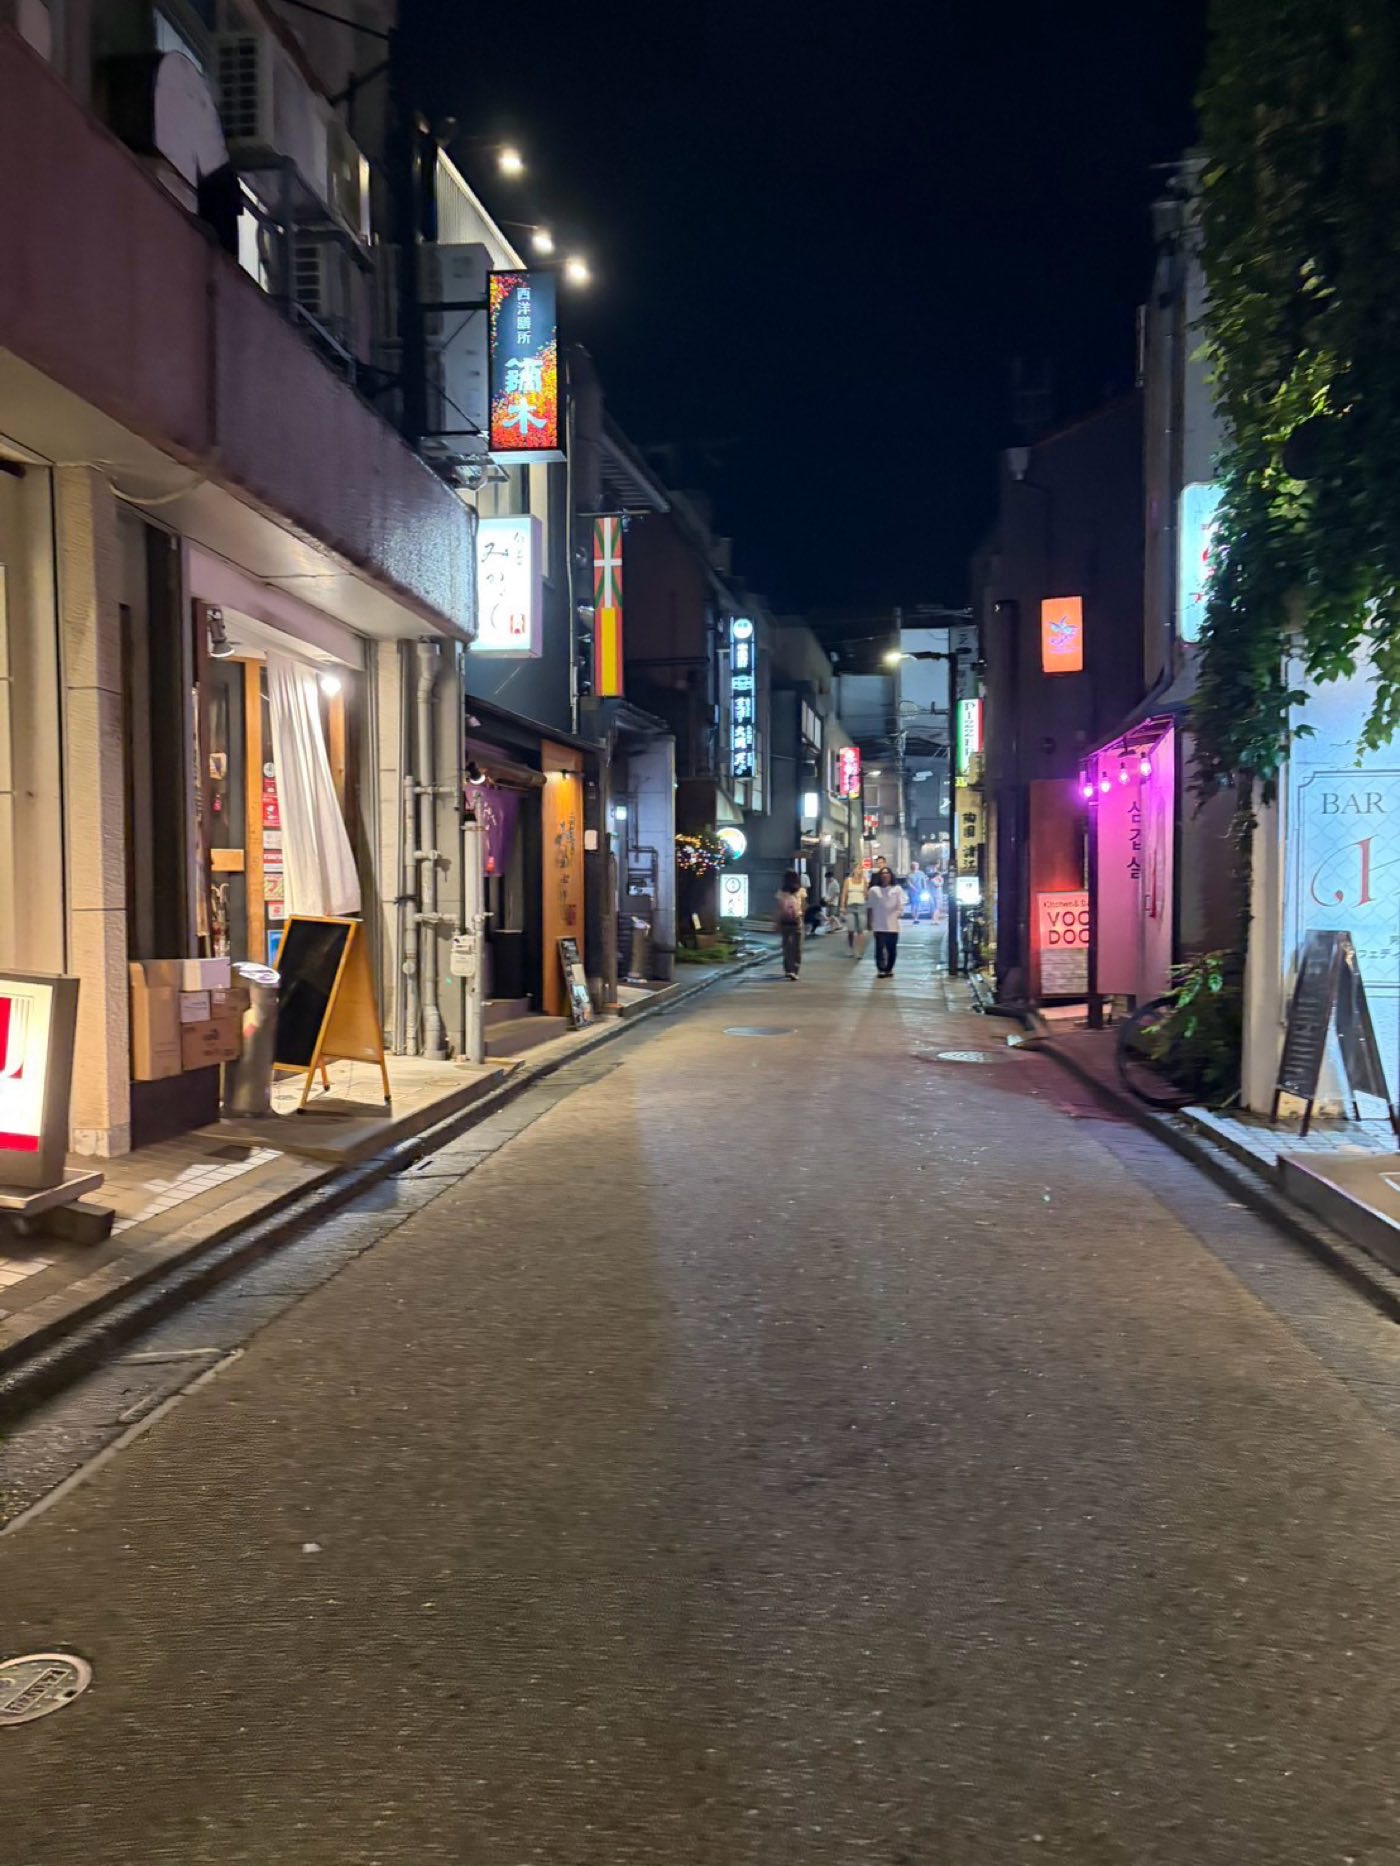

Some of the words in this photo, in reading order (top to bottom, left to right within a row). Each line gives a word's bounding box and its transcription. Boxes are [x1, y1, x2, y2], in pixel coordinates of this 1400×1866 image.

[516, 288, 532, 345] 西洋膳所
[1321, 791, 1387, 815] BAR
